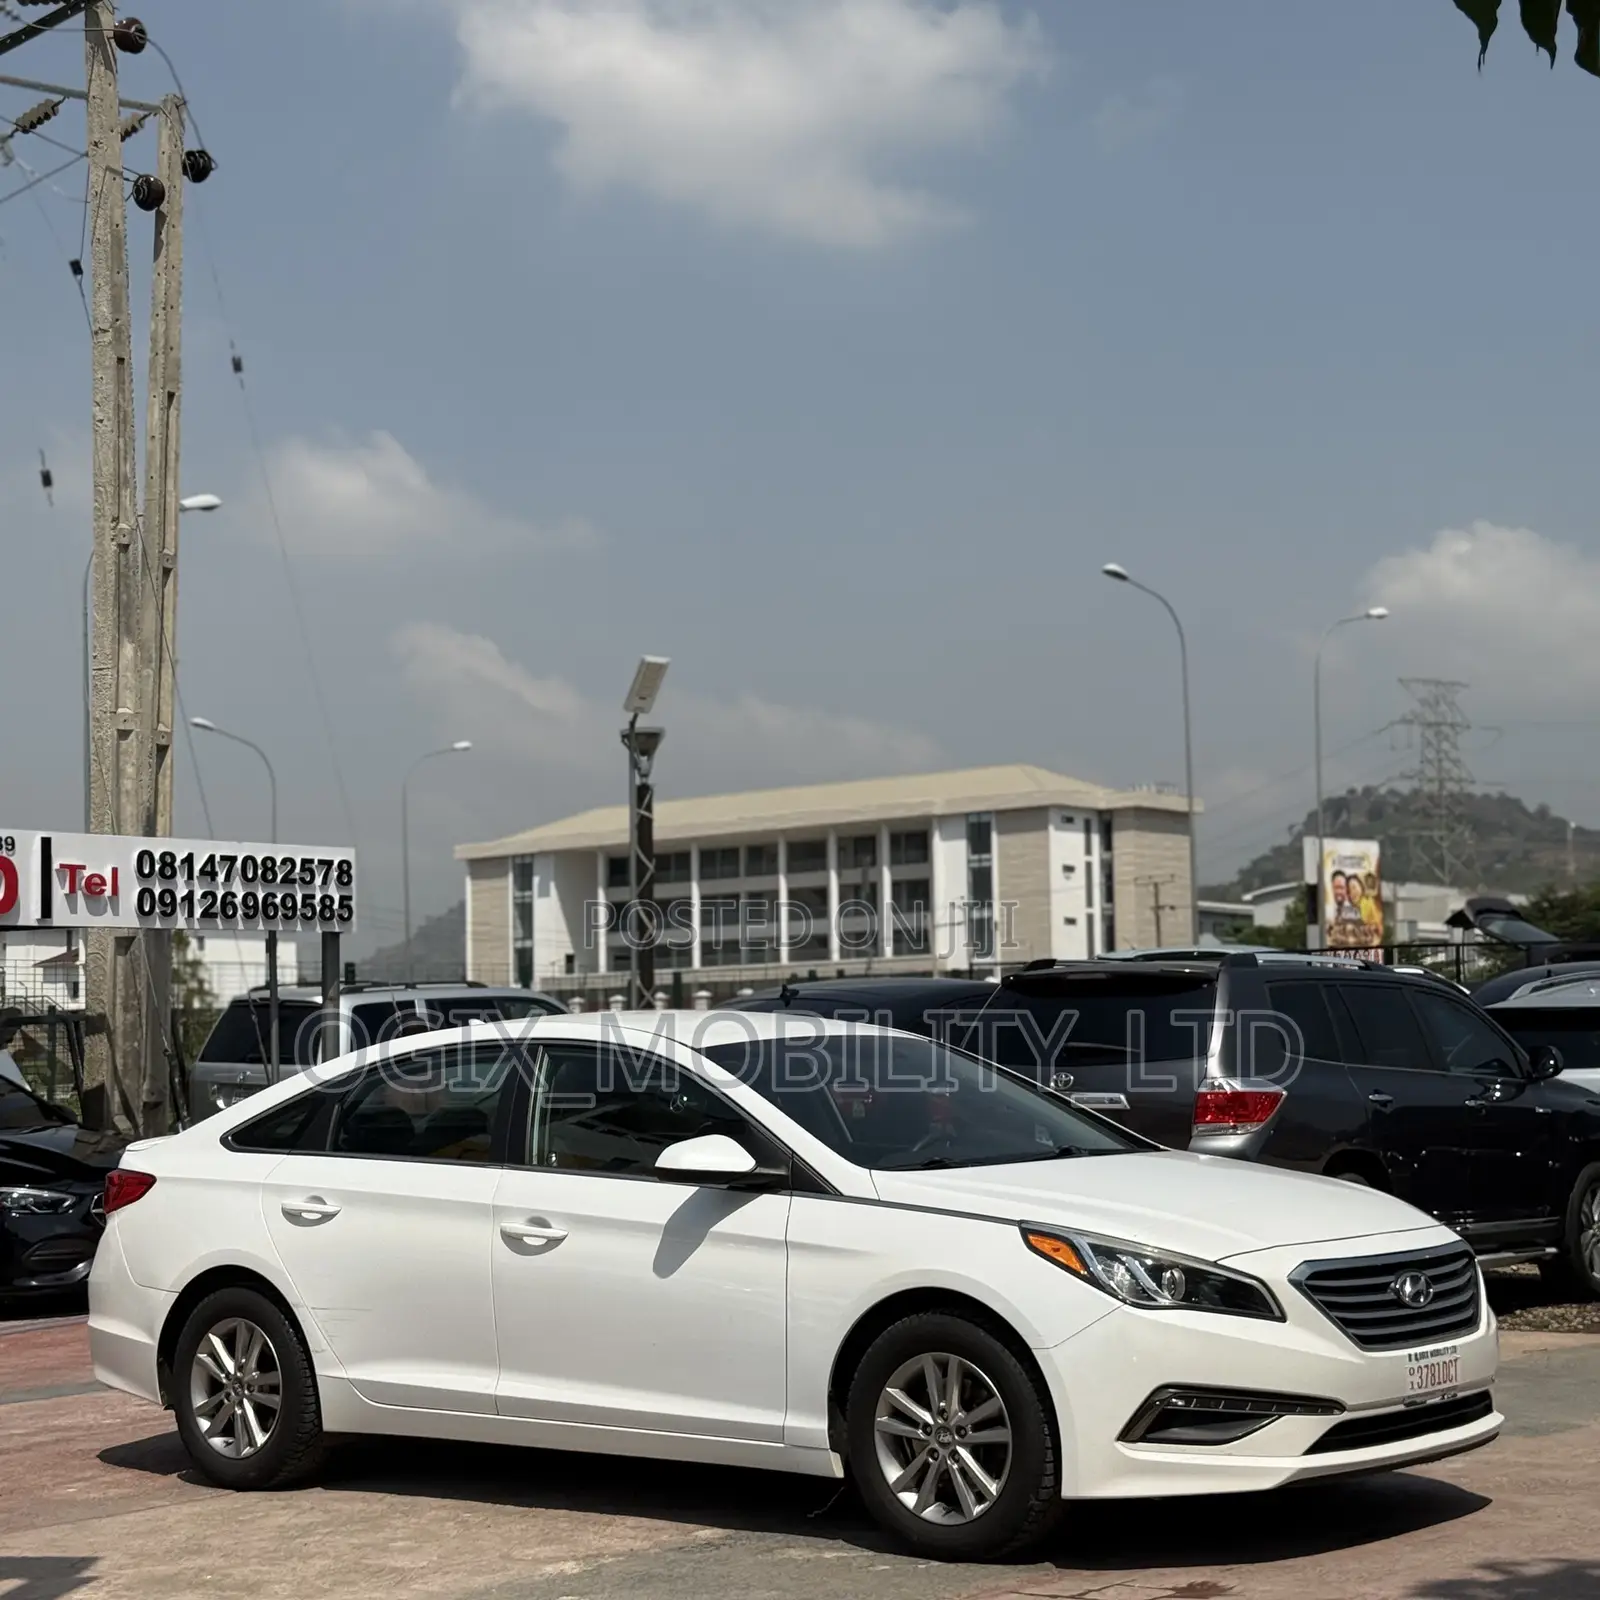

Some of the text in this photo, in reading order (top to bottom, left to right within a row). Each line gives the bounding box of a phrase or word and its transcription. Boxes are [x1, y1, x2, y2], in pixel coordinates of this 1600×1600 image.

[59, 863, 119, 897] Tel
[136, 849, 353, 887] 08147082578
[136, 887, 353, 923] 09126969585
[1417, 1359, 1458, 1389] 3781DCT
